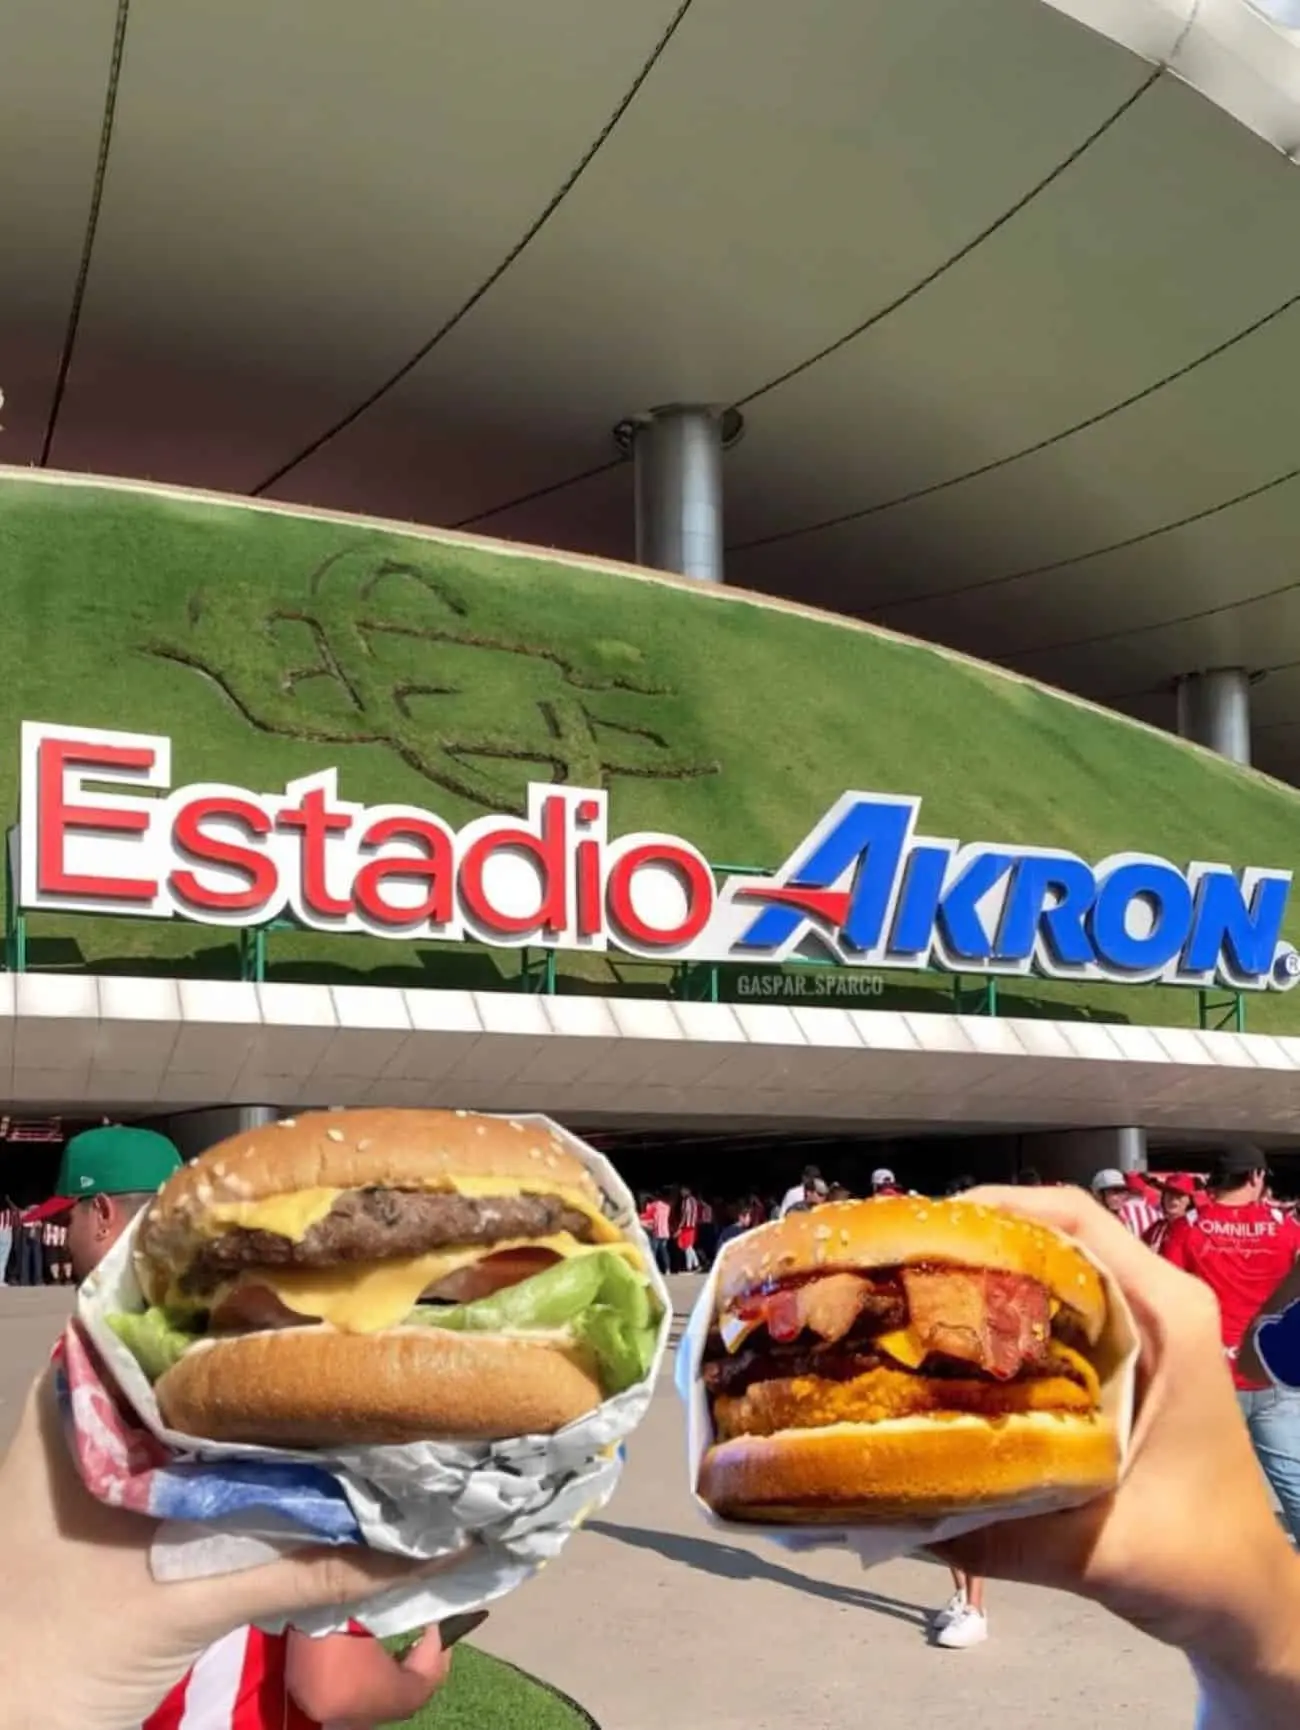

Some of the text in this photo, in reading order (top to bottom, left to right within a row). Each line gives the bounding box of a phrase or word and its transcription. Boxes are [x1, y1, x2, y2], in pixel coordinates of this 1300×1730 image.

[38, 738, 1291, 975] Estadio AKRON
[1200, 1219, 1277, 1237] OMNILIFE
